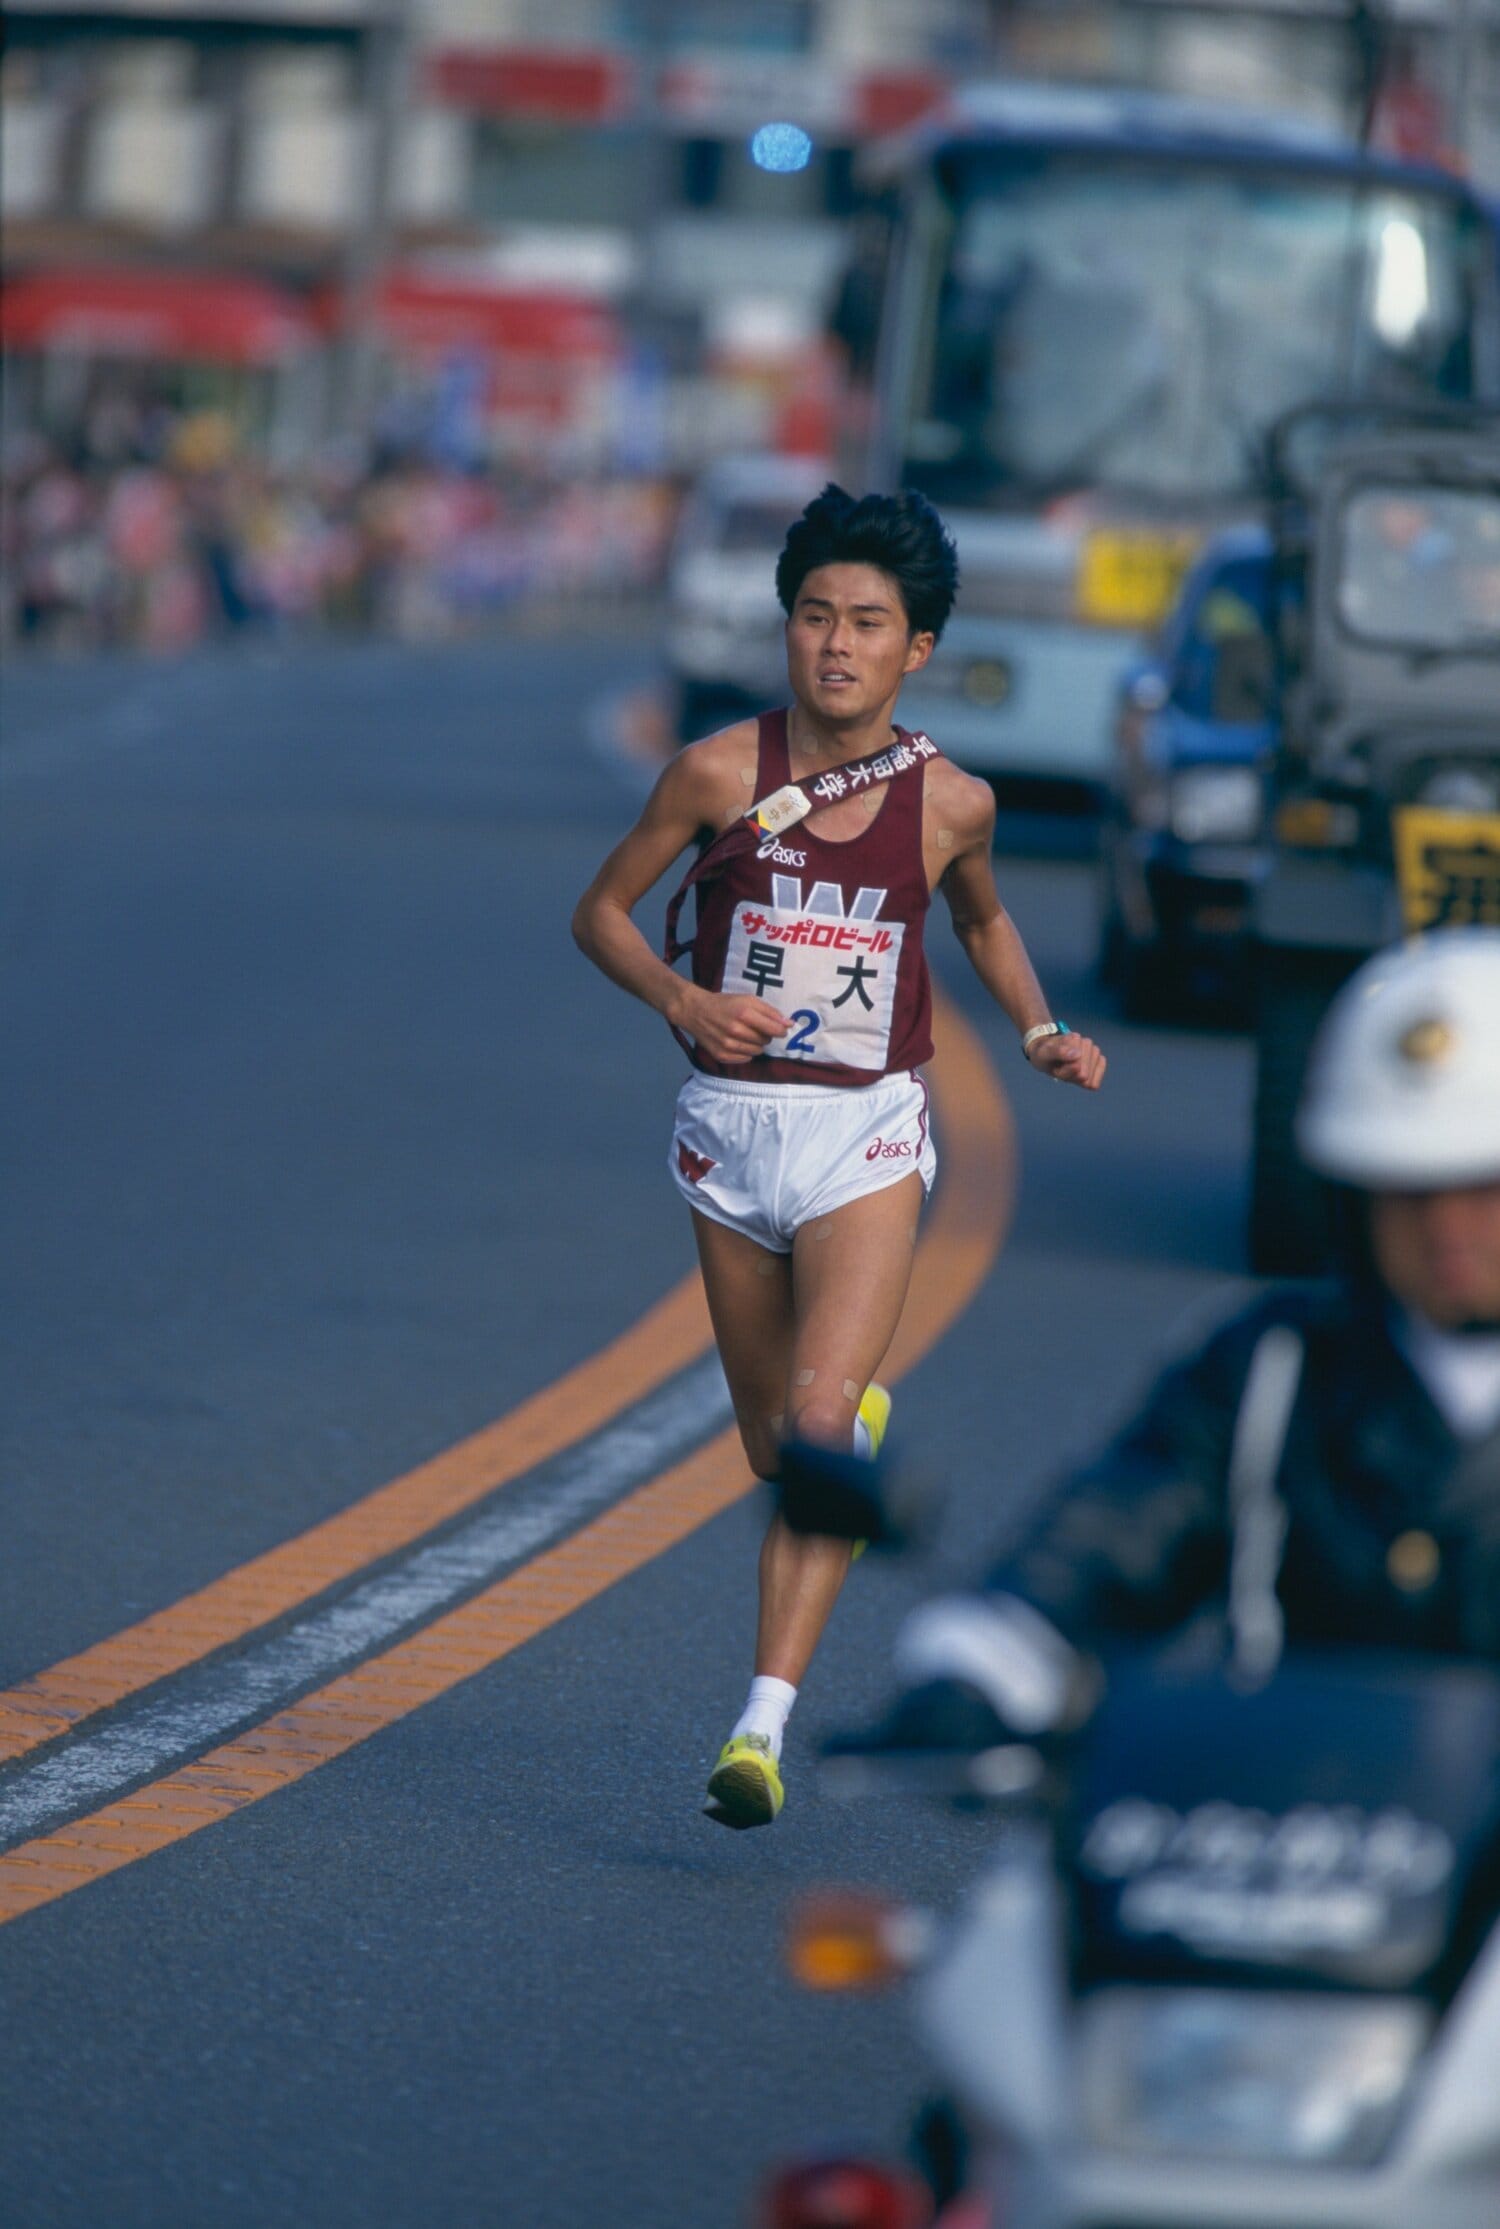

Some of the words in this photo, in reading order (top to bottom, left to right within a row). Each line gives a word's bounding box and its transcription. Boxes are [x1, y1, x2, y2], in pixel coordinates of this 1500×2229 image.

[814, 735, 938, 801] 早稲田大学
[741, 911, 893, 953] サッポロビール
[786, 1009, 820, 1053] 2
